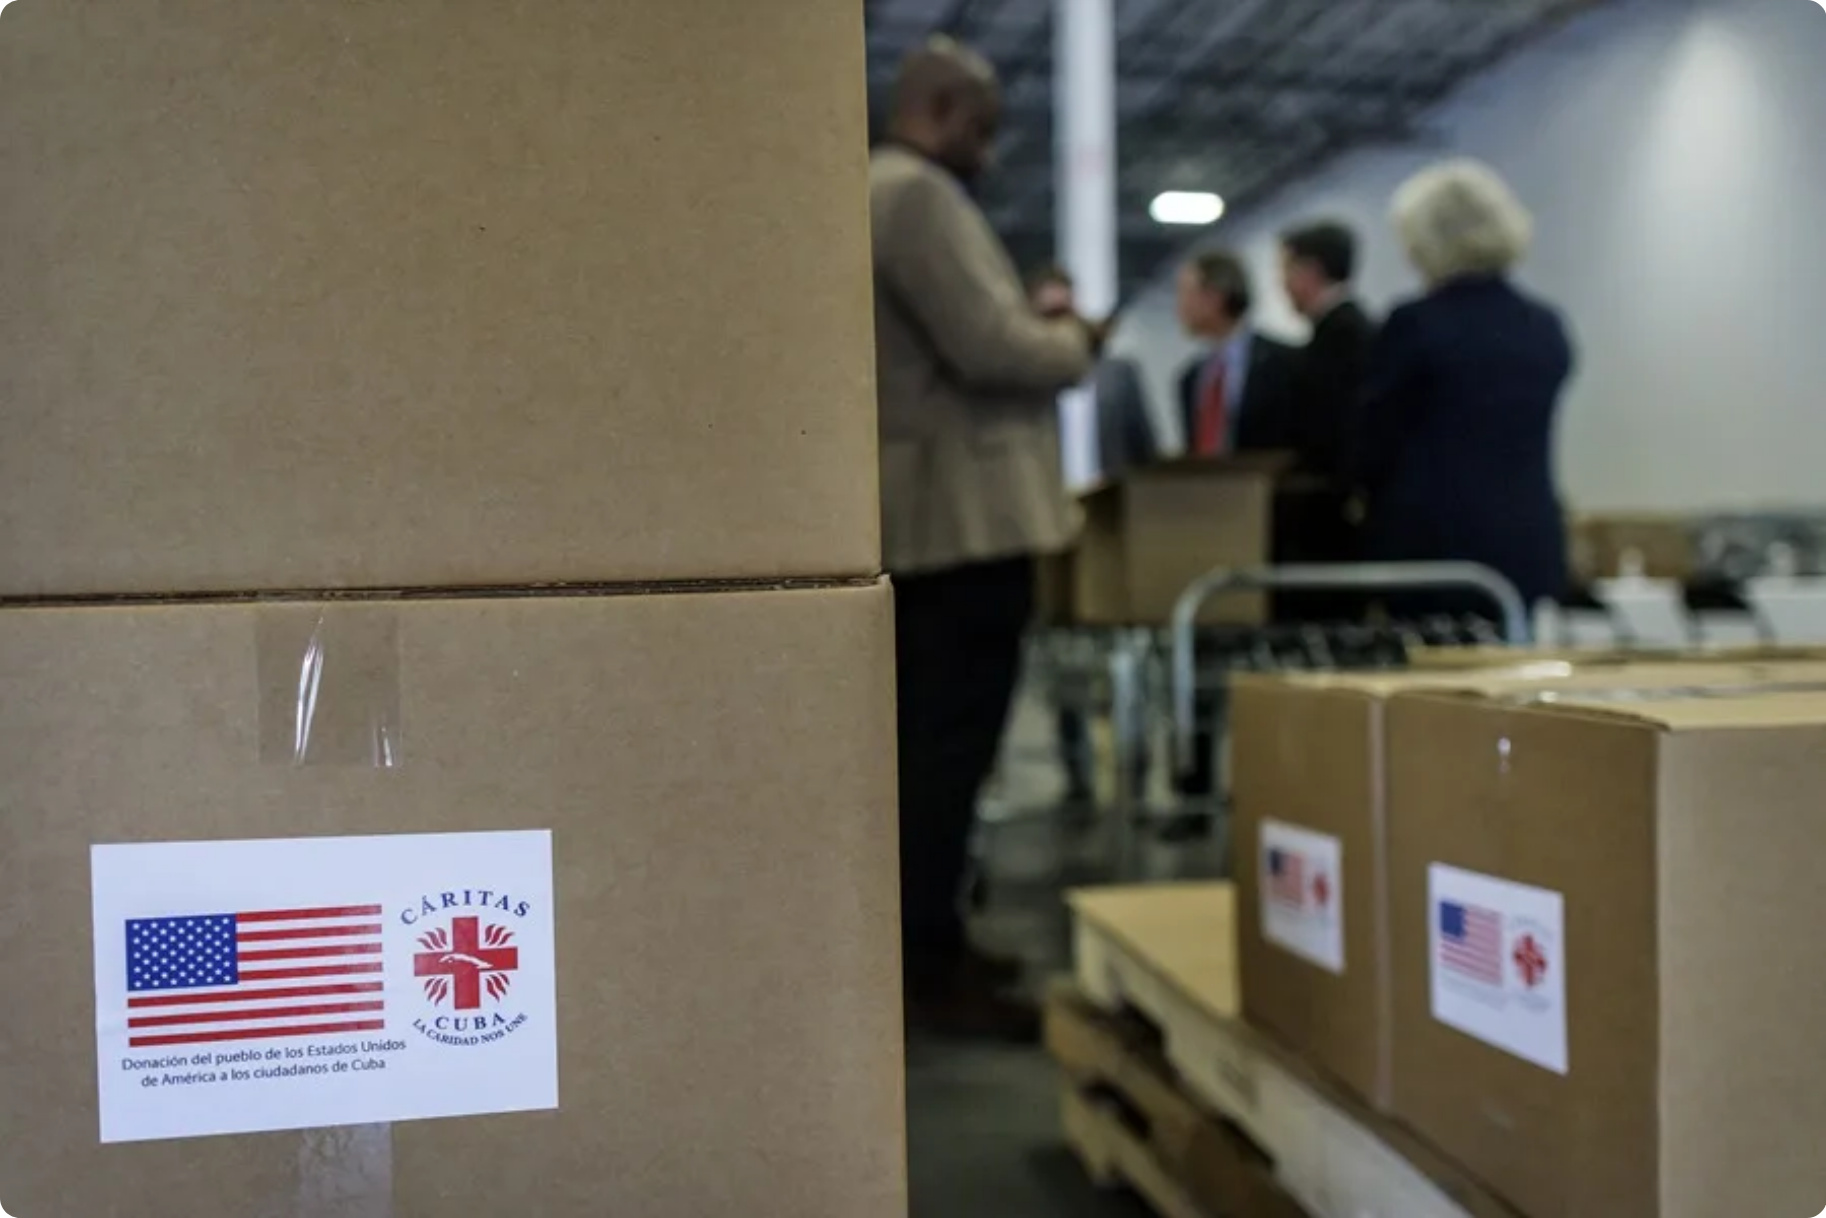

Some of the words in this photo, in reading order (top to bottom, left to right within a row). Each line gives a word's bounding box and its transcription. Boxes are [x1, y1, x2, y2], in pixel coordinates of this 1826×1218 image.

[401, 889, 531, 925] CÁRITAS
[412, 1018, 427, 1034] LA
[426, 1028, 479, 1046] CARIDAD
[481, 1029, 504, 1044] NOS
[505, 1012, 528, 1032] UNE
[435, 1012, 506, 1031] CUBA
[121, 1056, 188, 1071] Donación
[191, 1053, 212, 1066] del
[215, 1049, 262, 1067] pueblo
[265, 1047, 282, 1061] de
[284, 1046, 303, 1059] los
[307, 1043, 358, 1057] Estados
[361, 1038, 407, 1052] Unidos
[141, 1073, 158, 1087] de
[161, 1070, 216, 1086] América
[219, 1072, 229, 1082] a
[231, 1067, 250, 1081] los
[253, 1061, 329, 1079] ciudadanos
[332, 1059, 349, 1073] de
[351, 1057, 386, 1071] Cuba
